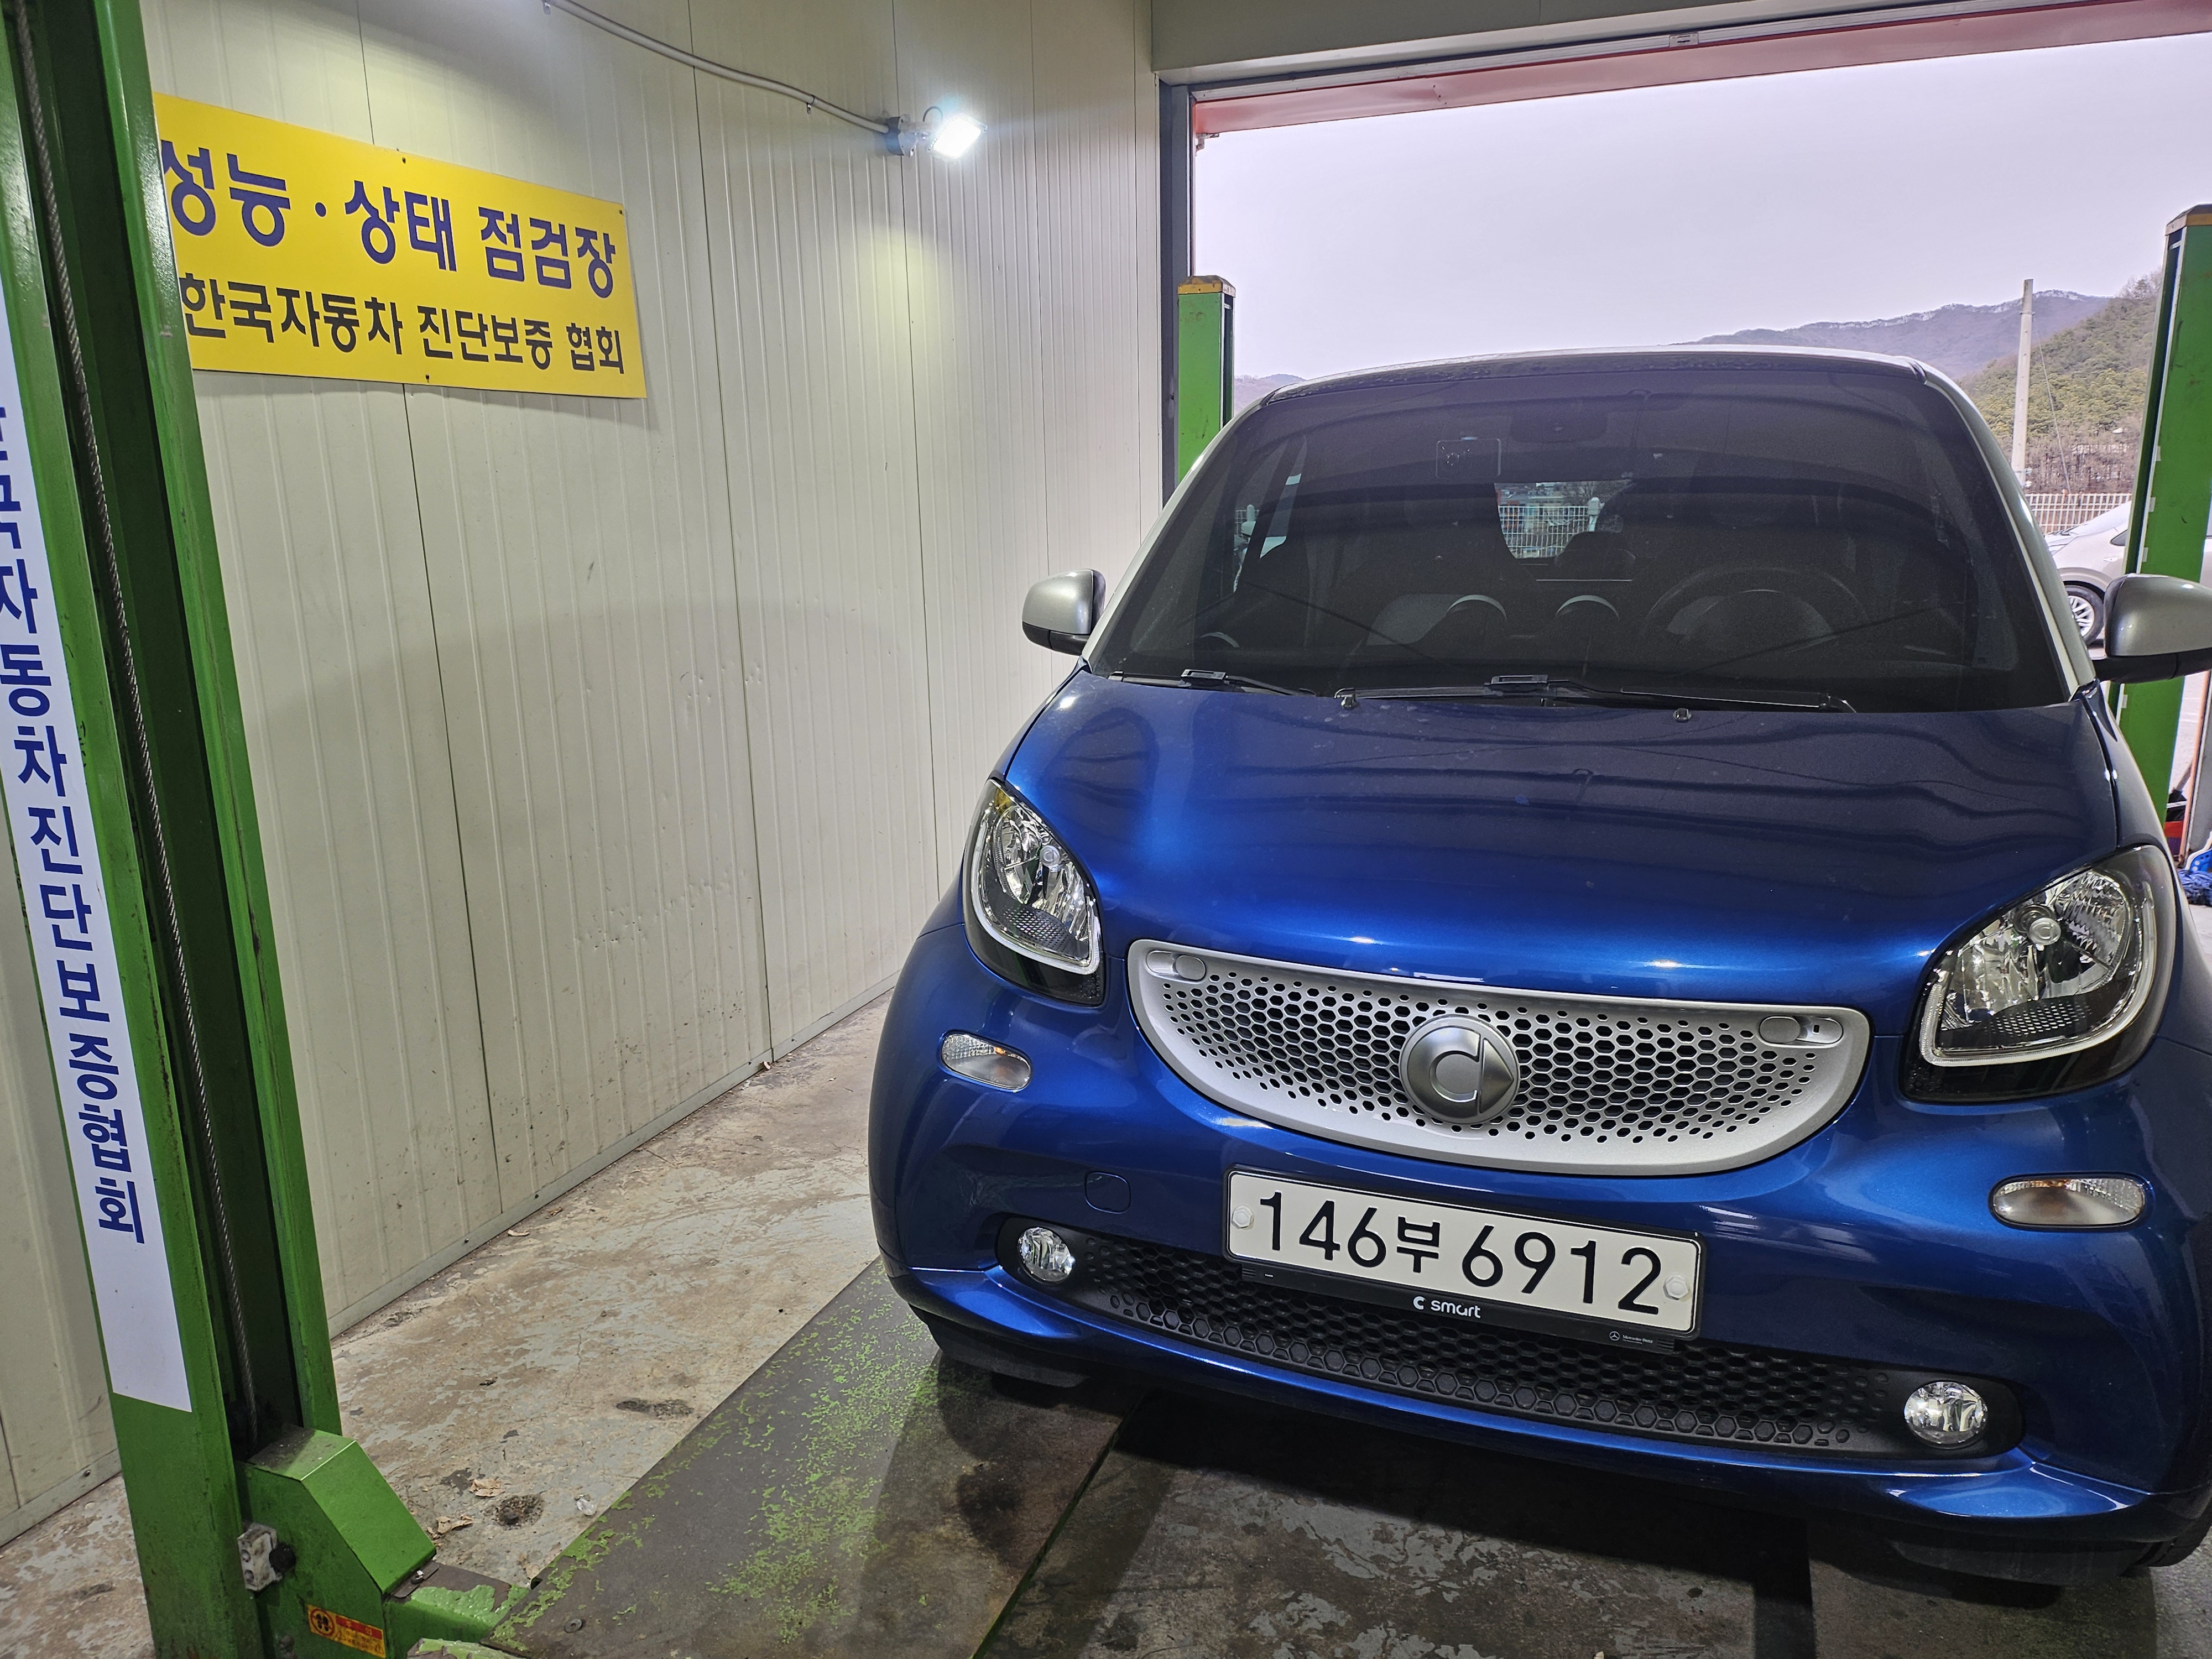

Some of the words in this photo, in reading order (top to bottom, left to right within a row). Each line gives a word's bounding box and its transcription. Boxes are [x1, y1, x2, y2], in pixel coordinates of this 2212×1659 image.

[478, 206, 616, 299] 점검장
[179, 272, 403, 355] 한국자동차
[417, 305, 553, 370] 진단보증
[566, 322, 624, 374] 협회
[1260, 1191, 1441, 1274] 146부
[1462, 1225, 1661, 1315] 6912
[1430, 1300, 1481, 1319] smart
